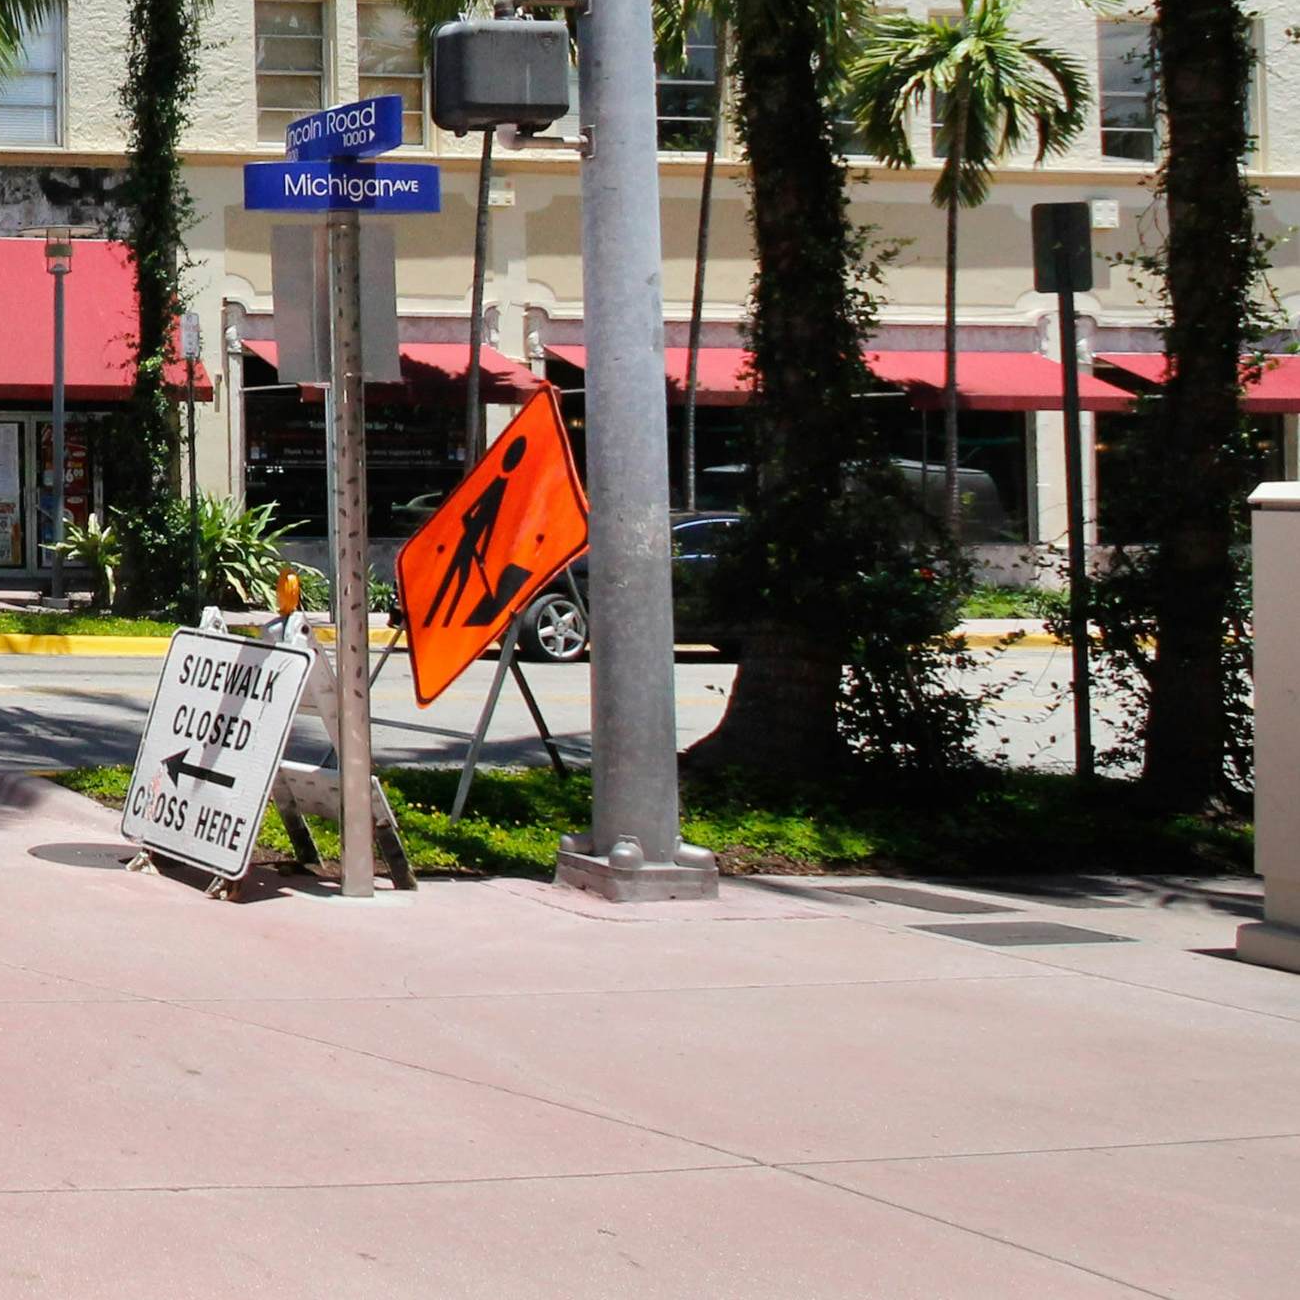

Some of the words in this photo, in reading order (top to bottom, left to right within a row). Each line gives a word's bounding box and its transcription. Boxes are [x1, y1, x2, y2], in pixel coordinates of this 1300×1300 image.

[286, 118, 322, 148] incoln
[326, 102, 376, 135] Road
[343, 129, 367, 147] 1000
[284, 173, 393, 202] Michigan
[393, 180, 419, 193] AVE
[178, 654, 280, 703] SIDEWALK
[173, 705, 252, 751] CLOSED
[194, 806, 246, 852] HERE
